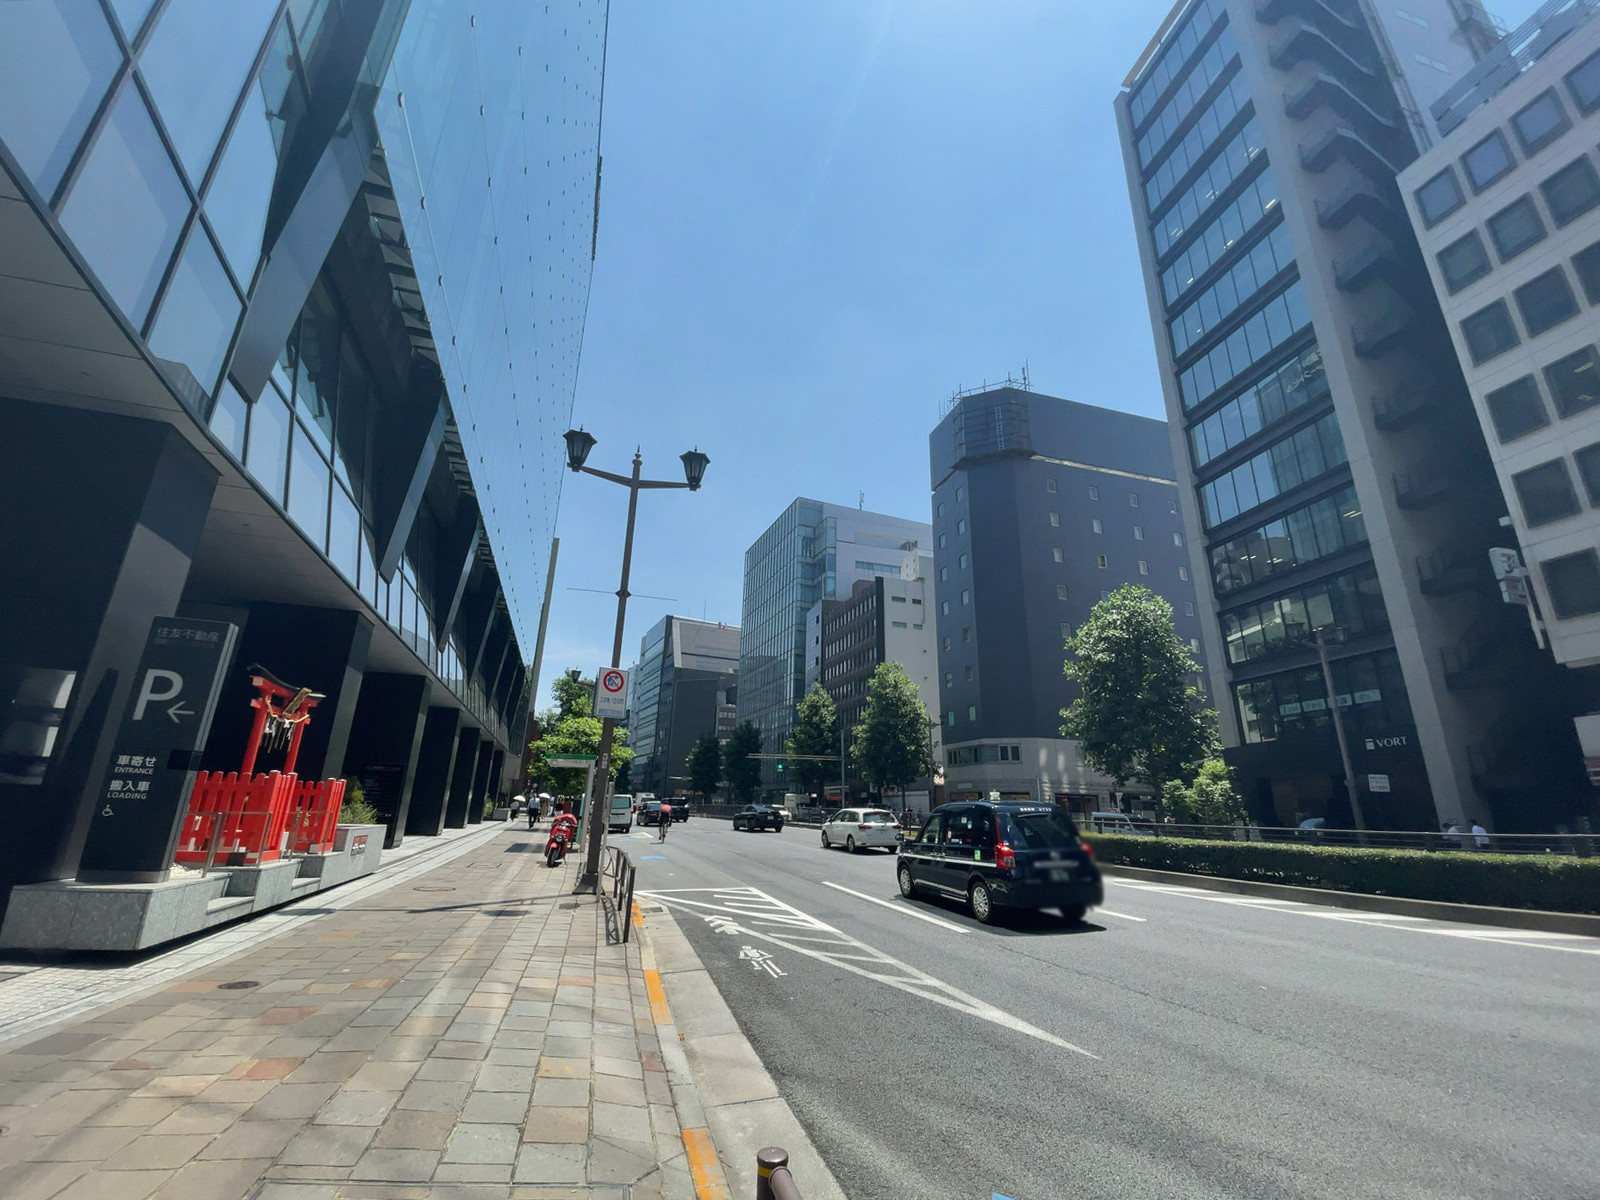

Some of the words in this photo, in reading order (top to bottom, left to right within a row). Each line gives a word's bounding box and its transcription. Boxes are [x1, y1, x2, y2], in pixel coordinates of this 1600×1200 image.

[132, 669, 184, 721] P
[1376, 736, 1407, 748] VORT
[117, 755, 157, 767] 車寄せ
[114, 766, 154, 775] ENTRANCE
[109, 780, 151, 792] 搬入車
[107, 791, 148, 800] LOADING
